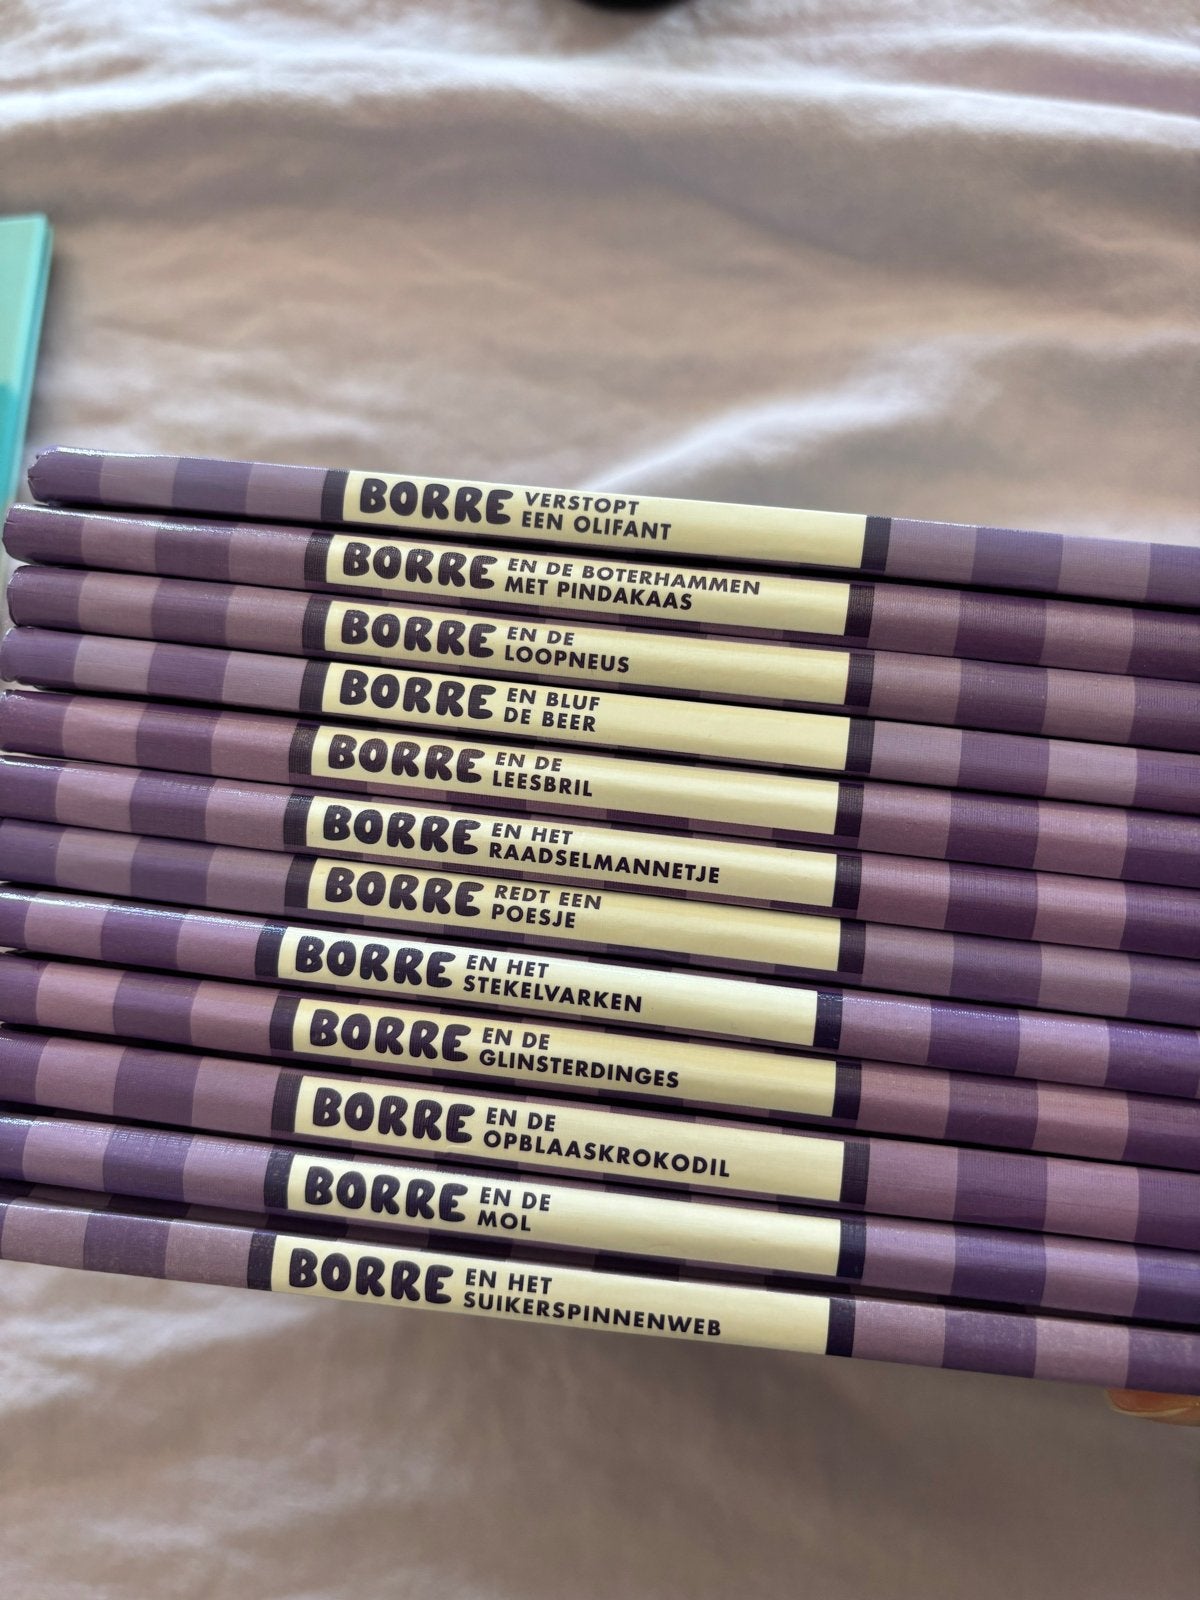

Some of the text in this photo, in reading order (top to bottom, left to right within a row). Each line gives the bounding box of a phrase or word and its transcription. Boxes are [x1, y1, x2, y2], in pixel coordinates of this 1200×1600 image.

[359, 478, 514, 525] BORRE
[525, 491, 639, 516] VERSTOPT
[521, 510, 672, 541] EEN OLIFANT
[342, 542, 498, 590] BORRE
[507, 558, 760, 595] EN DE BOTERHAMMEN
[504, 575, 692, 611] MET PINDAKAAS
[340, 609, 497, 659] BORRE
[507, 626, 575, 646] EN DE
[504, 644, 630, 674] LOOPNEUS
[339, 669, 497, 720] BORRE
[506, 687, 601, 711] EN BLUF
[503, 706, 596, 733] DE BEER
[327, 734, 486, 784] BORRE
[495, 751, 563, 772] EN DE
[492, 770, 593, 798] LEESBRIL
[322, 804, 481, 856] BORRE
[491, 822, 573, 845] EN HET
[489, 841, 720, 884] RAADSELMANNETJE
[324, 866, 485, 917] BORRE
[494, 884, 602, 910] REDT EEN
[491, 903, 576, 929] POESJE
[295, 935, 456, 989] BORRE
[466, 954, 549, 979] EN HET
[462, 974, 642, 1014] STEKELVARKEN
[309, 1009, 472, 1063] BORRE
[482, 1027, 550, 1051] EN DE
[479, 1048, 679, 1089] GLINSTERDINGES
[312, 1087, 476, 1144] BORRE
[486, 1107, 556, 1133] EN DE
[483, 1129, 730, 1178] OPBLAASKROKODIL
[304, 1166, 468, 1223] BORRE
[479, 1186, 551, 1212] EN DE
[476, 1209, 531, 1232] MOL
[288, 1248, 454, 1305] BORRE
[465, 1268, 553, 1295] EN HET
[463, 1291, 721, 1337] SUIKERSPINNENWEB
